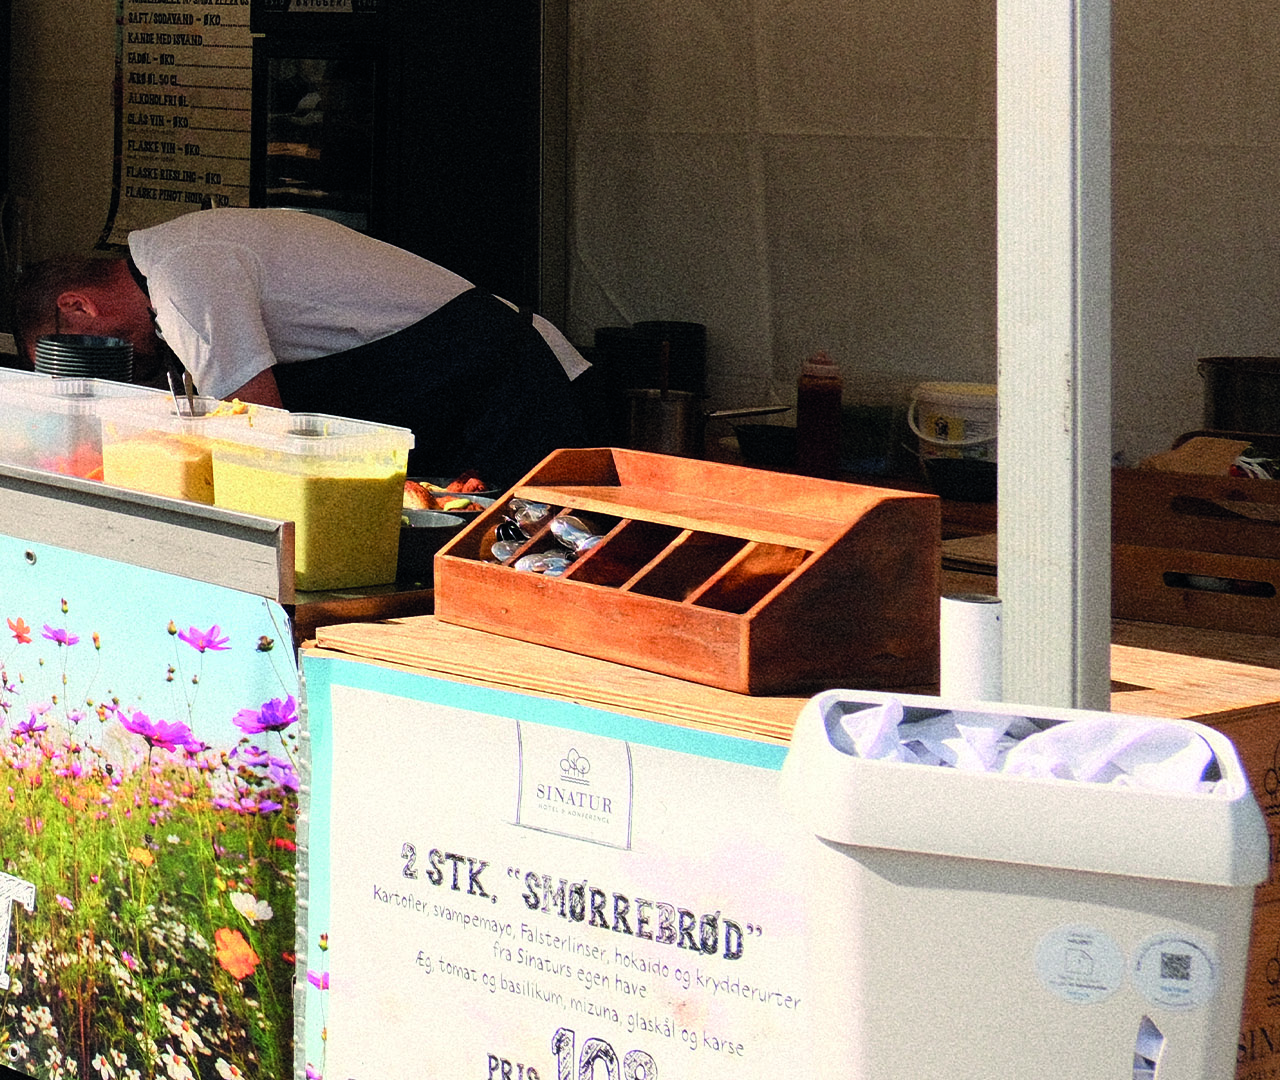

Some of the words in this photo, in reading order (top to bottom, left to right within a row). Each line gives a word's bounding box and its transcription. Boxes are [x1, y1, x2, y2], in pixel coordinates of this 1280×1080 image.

[536, 783, 612, 814] SINATUR
[373, 884, 430, 917] Kartofler,
[433, 904, 516, 940] svampemayo,
[520, 922, 610, 965] Falsterlinser,
[615, 944, 669, 978] hokaido
[675, 969, 690, 989] og
[696, 968, 802, 1011] krydderurter
[400, 841, 418, 880] 2
[426, 848, 498, 904] STK.
[507, 866, 763, 961] “SMØRREBRØD”
[415, 950, 435, 974] Æg,
[439, 956, 477, 982] tomat
[482, 973, 496, 993] og
[500, 972, 567, 1010] basilikum,
[570, 997, 622, 1025] mizuna,
[627, 1012, 675, 1039] glaskål
[681, 1028, 698, 1051] og
[703, 1031, 744, 1057] karse
[493, 941, 512, 962] fra
[517, 947, 572, 977] Sinaturs
[577, 968, 609, 990] egen
[615, 973, 647, 999] have
